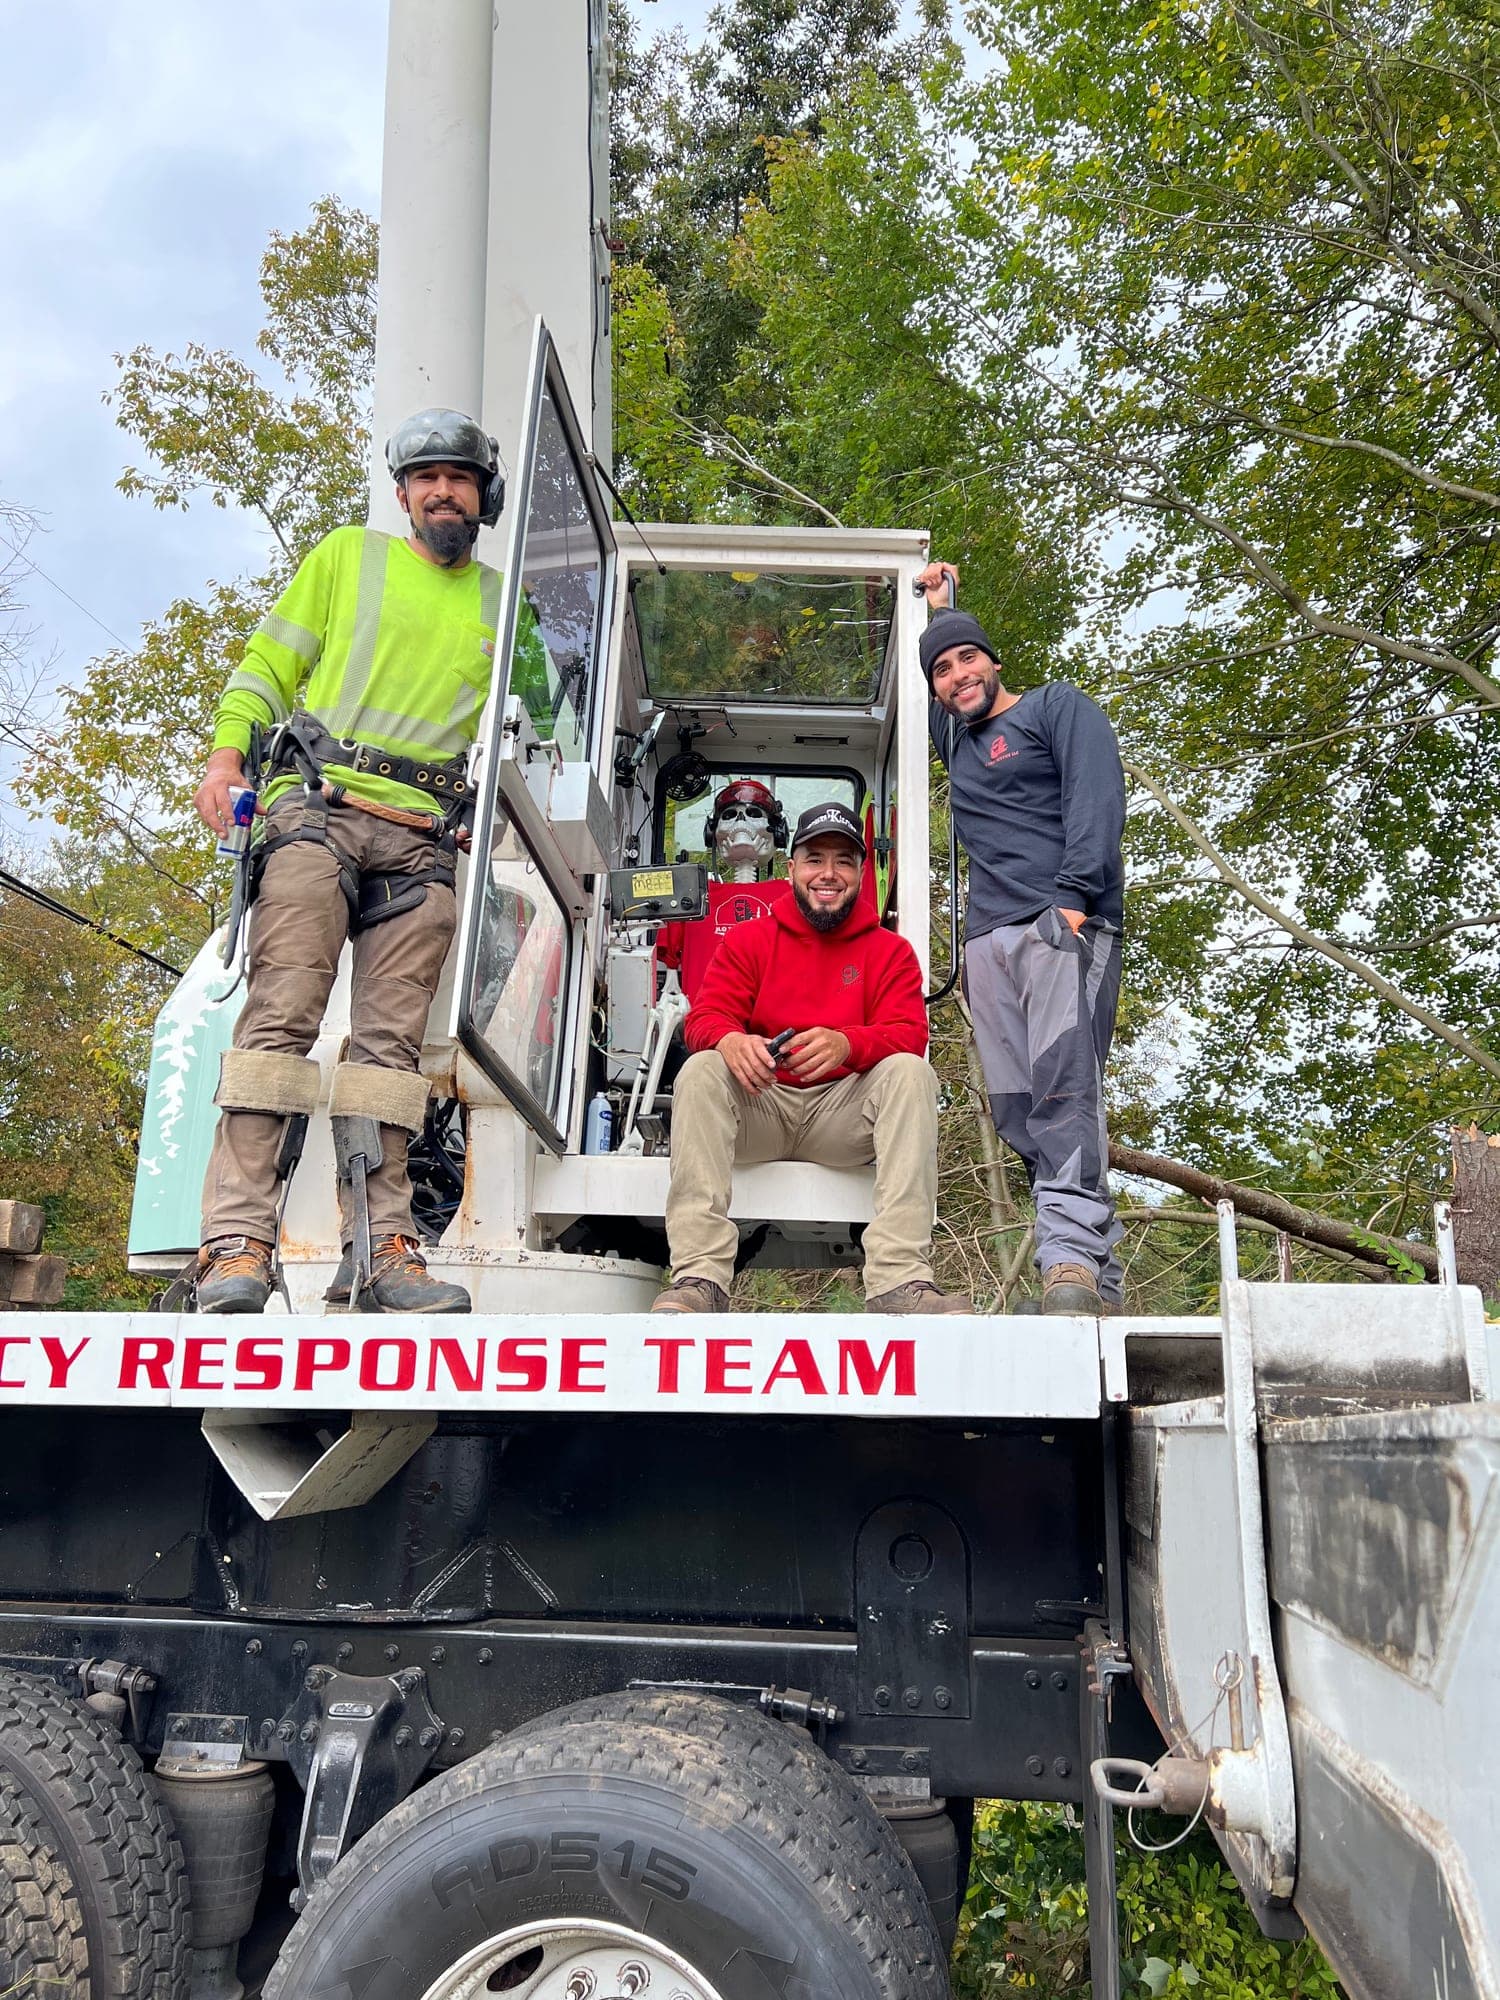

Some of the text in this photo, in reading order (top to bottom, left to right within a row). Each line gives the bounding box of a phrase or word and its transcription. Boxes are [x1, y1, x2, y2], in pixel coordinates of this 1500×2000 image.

[117, 1337, 607, 1392] RESPONSE
[644, 1338, 917, 1396] TEAM
[431, 1831, 698, 1911] AD515
